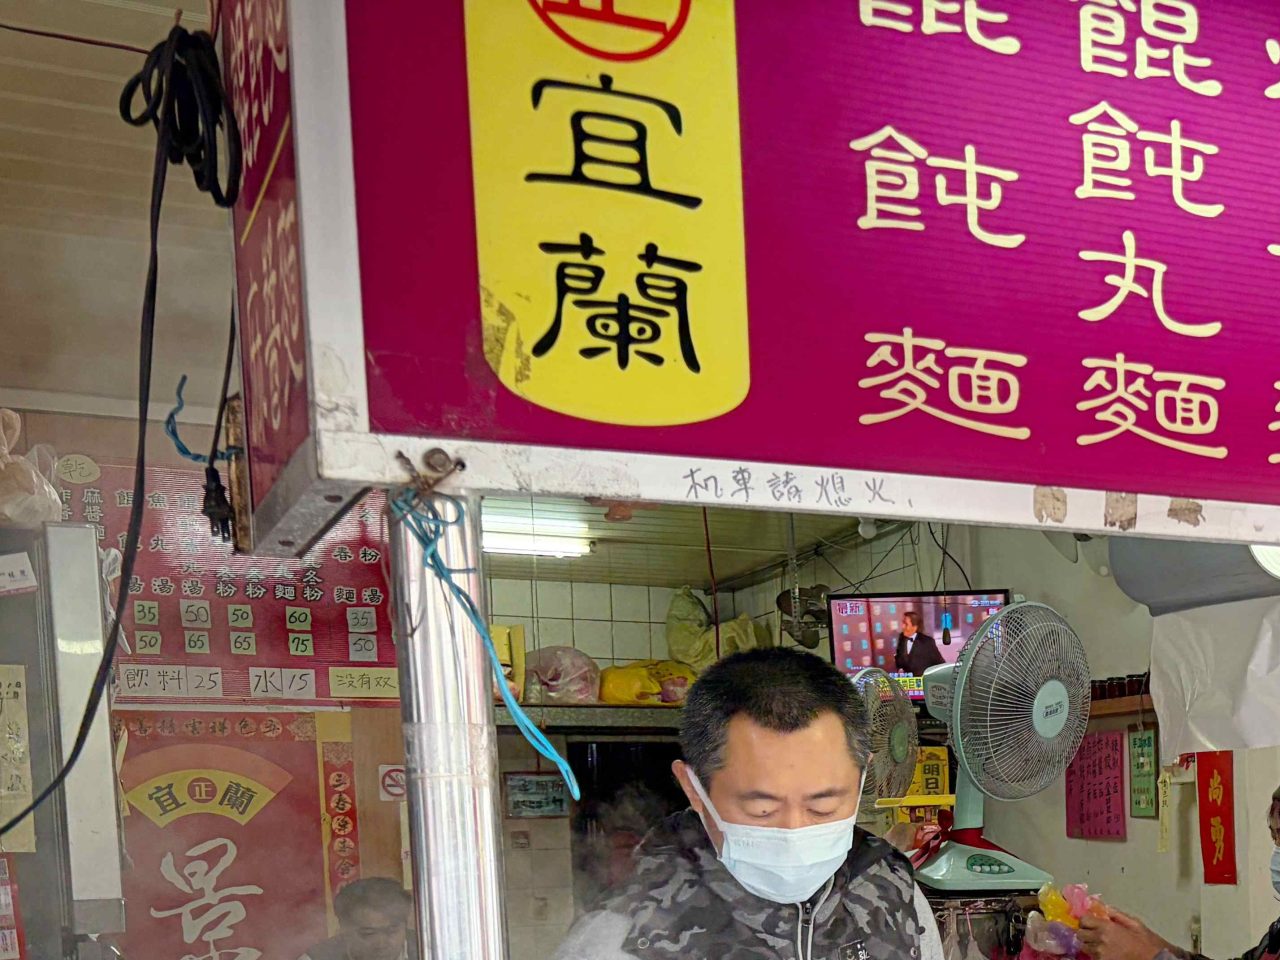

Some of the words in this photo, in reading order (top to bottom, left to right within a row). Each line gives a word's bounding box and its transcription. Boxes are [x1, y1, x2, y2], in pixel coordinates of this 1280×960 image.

[524, 73, 704, 375] 宜蘭
[1068, 0, 1229, 460] 餛飩丸麵
[136, 604, 157, 621] 35
[184, 604, 210, 623] 50
[231, 607, 250, 621] 50
[288, 608, 308, 624] 60
[138, 634, 159, 649] 50
[187, 631, 206, 648] 65
[232, 634, 252, 649] 65
[290, 637, 310, 652] 75
[194, 672, 220, 691] 25
